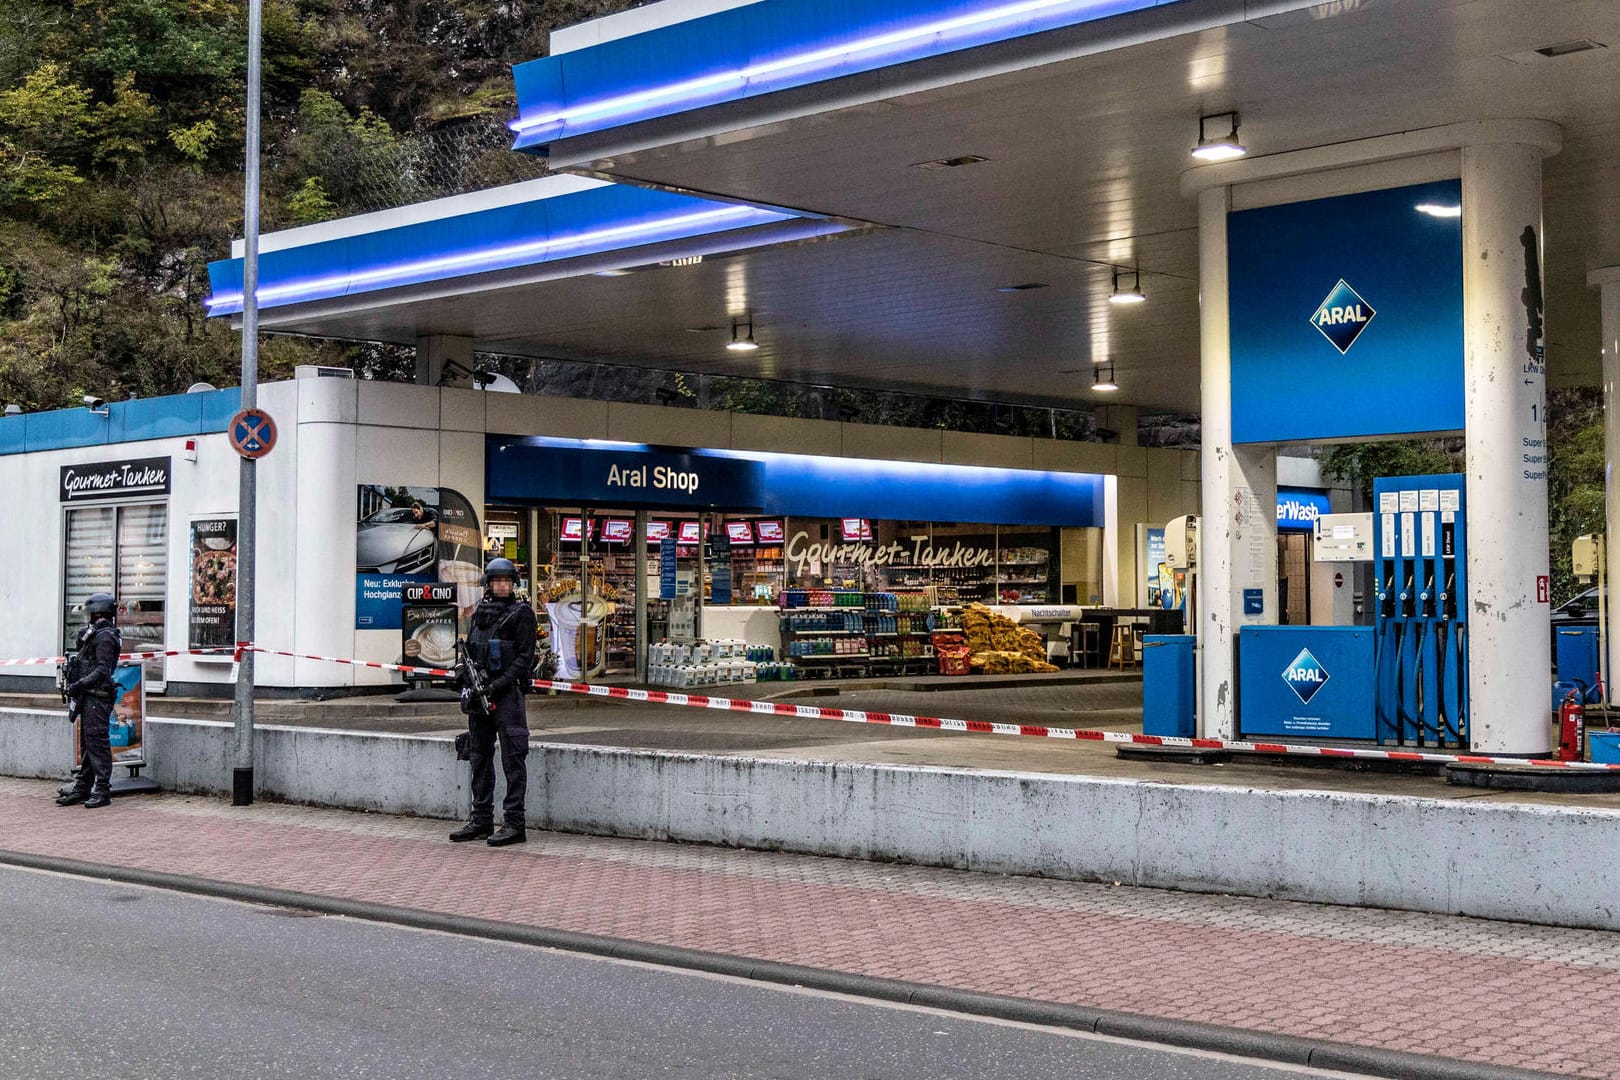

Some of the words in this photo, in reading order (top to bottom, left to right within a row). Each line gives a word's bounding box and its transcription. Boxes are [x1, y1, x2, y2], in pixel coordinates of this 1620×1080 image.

[1319, 304, 1367, 327] ARAL
[1531, 404, 1537, 422] 1
[1522, 437, 1543, 448] Super
[1523, 453, 1543, 464] Super
[64, 464, 166, 499] Gourmet-Tanken
[607, 464, 647, 487] Aral
[653, 466, 699, 495] Shop
[1276, 500, 1319, 520] erWash
[1315, 517, 1321, 533] 1
[787, 531, 992, 577] Gourmet-Tanken
[364, 579, 381, 588] Neu:
[549, 578, 578, 599] Coffee
[1031, 608, 1072, 618] Nachtschalter
[1288, 668, 1324, 682] ARAL
